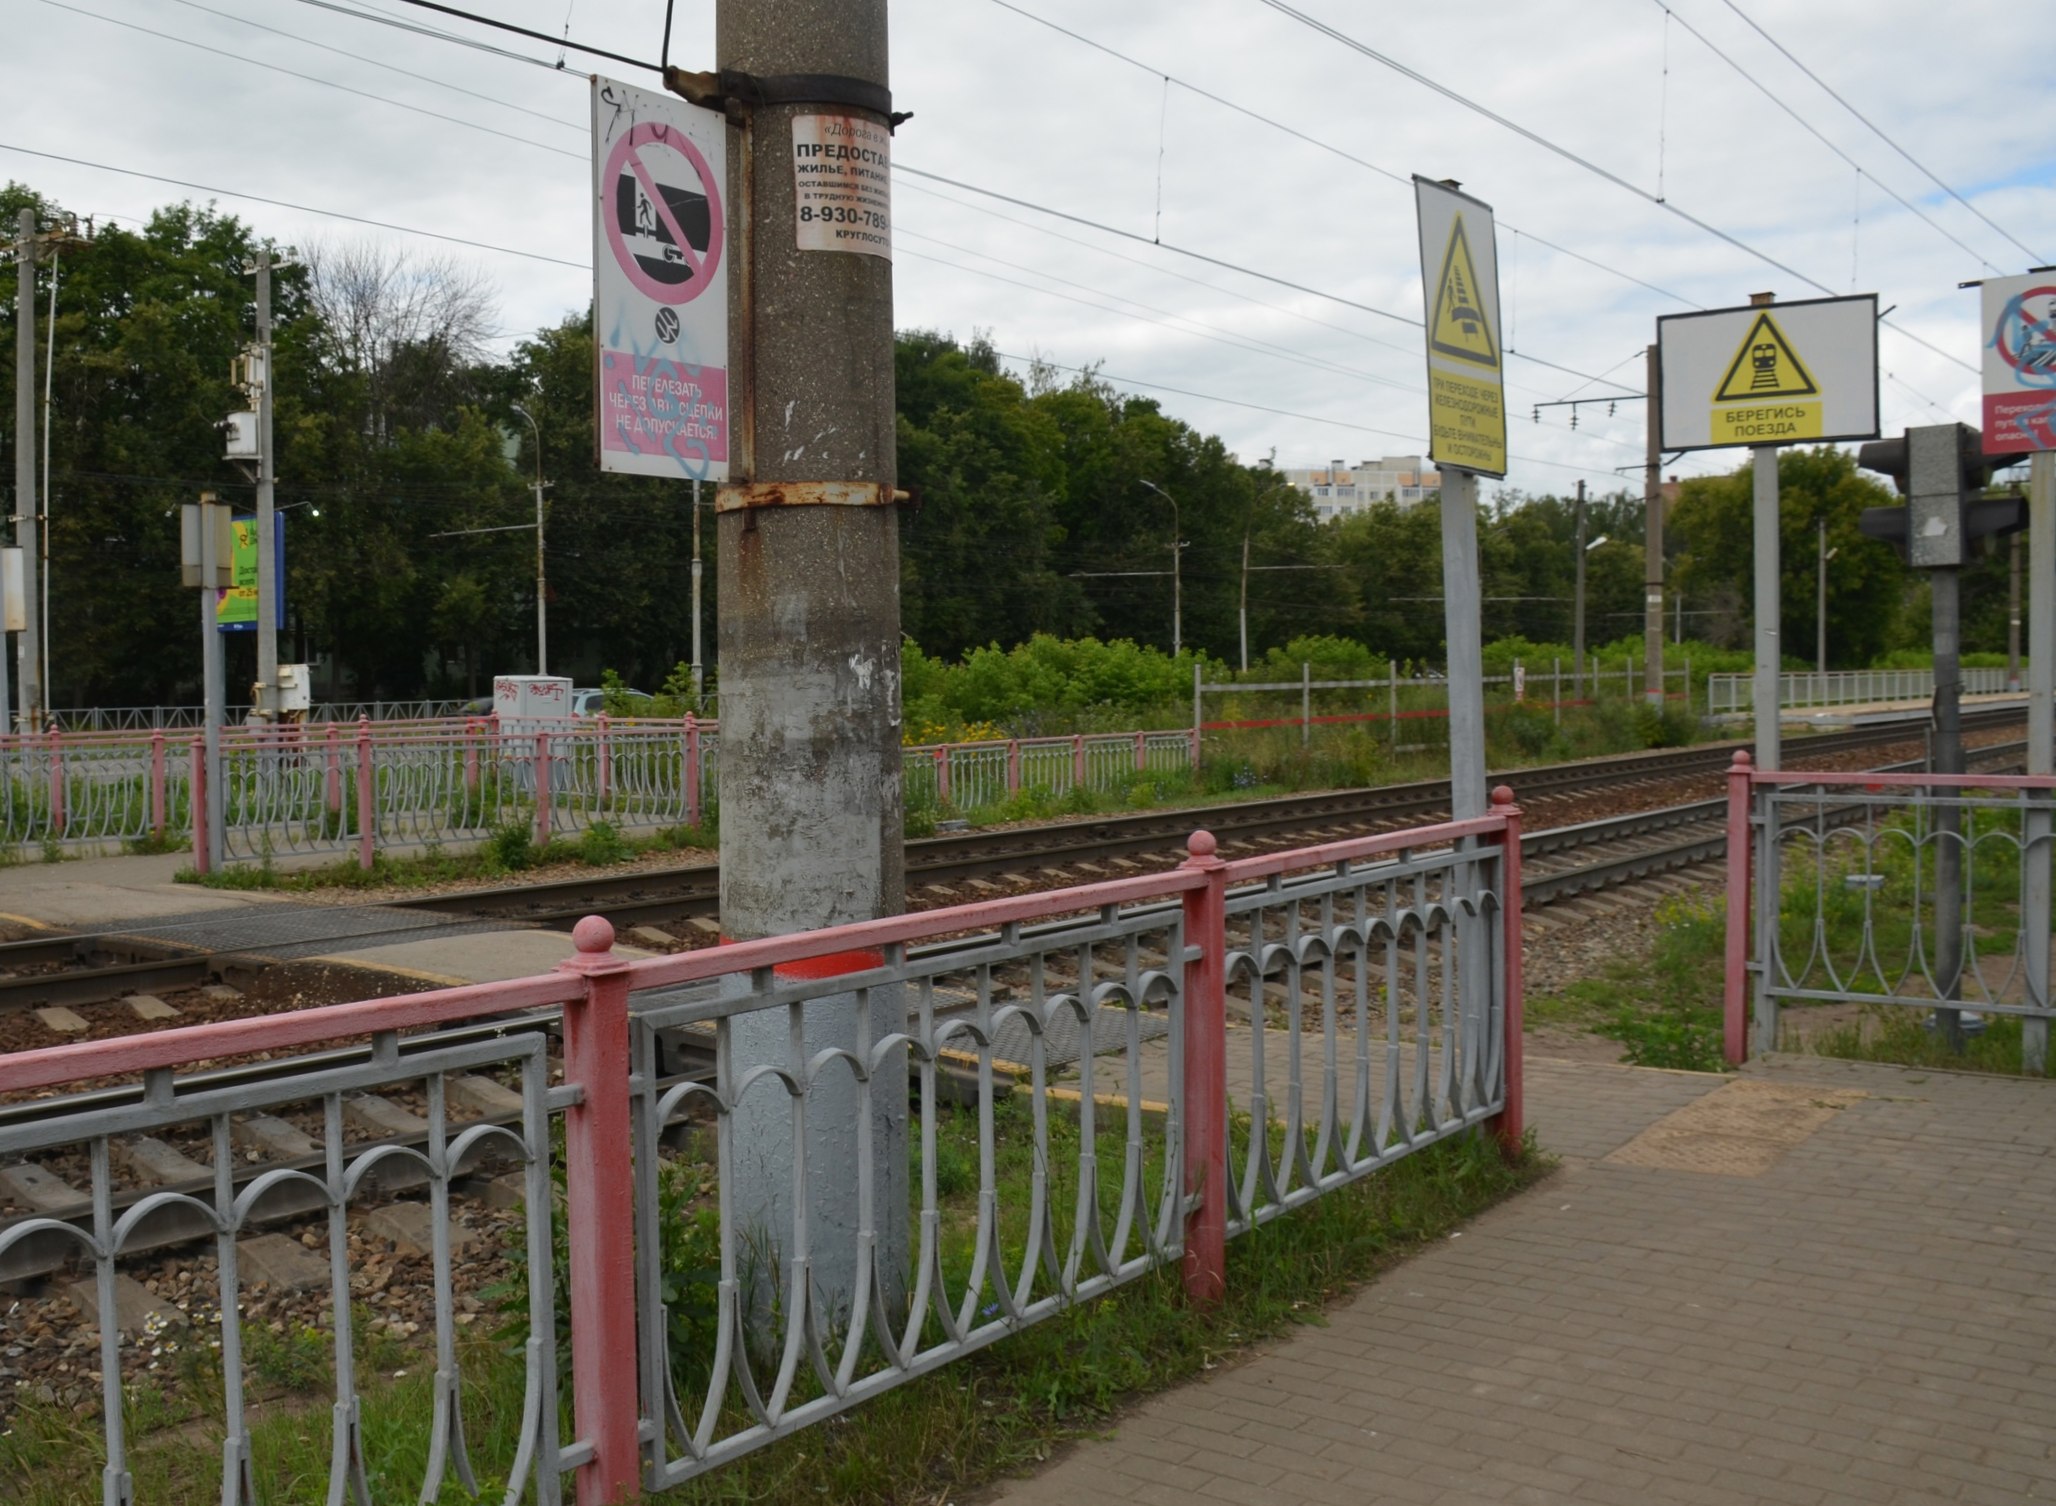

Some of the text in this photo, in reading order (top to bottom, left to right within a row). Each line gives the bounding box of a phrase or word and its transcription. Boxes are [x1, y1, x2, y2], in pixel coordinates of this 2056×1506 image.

[824, 123, 872, 140] «Дорога
[797, 164, 848, 177] ЖИЛЬЕ,
[797, 180, 860, 191] ОСТАВШИМСЯ
[804, 192, 811, 200] В
[813, 192, 854, 202] ТРУДНУЮ
[1446, 380, 1480, 399] ПЕРЕХОДЕ
[609, 391, 723, 421] ЧЕРЕЗ ВТСЦЕПКИ
[615, 413, 632, 430] НЕ
[1725, 406, 1806, 424] БЕРЕГИСЬ
[1735, 422, 1797, 437] ПОЕЗДА
